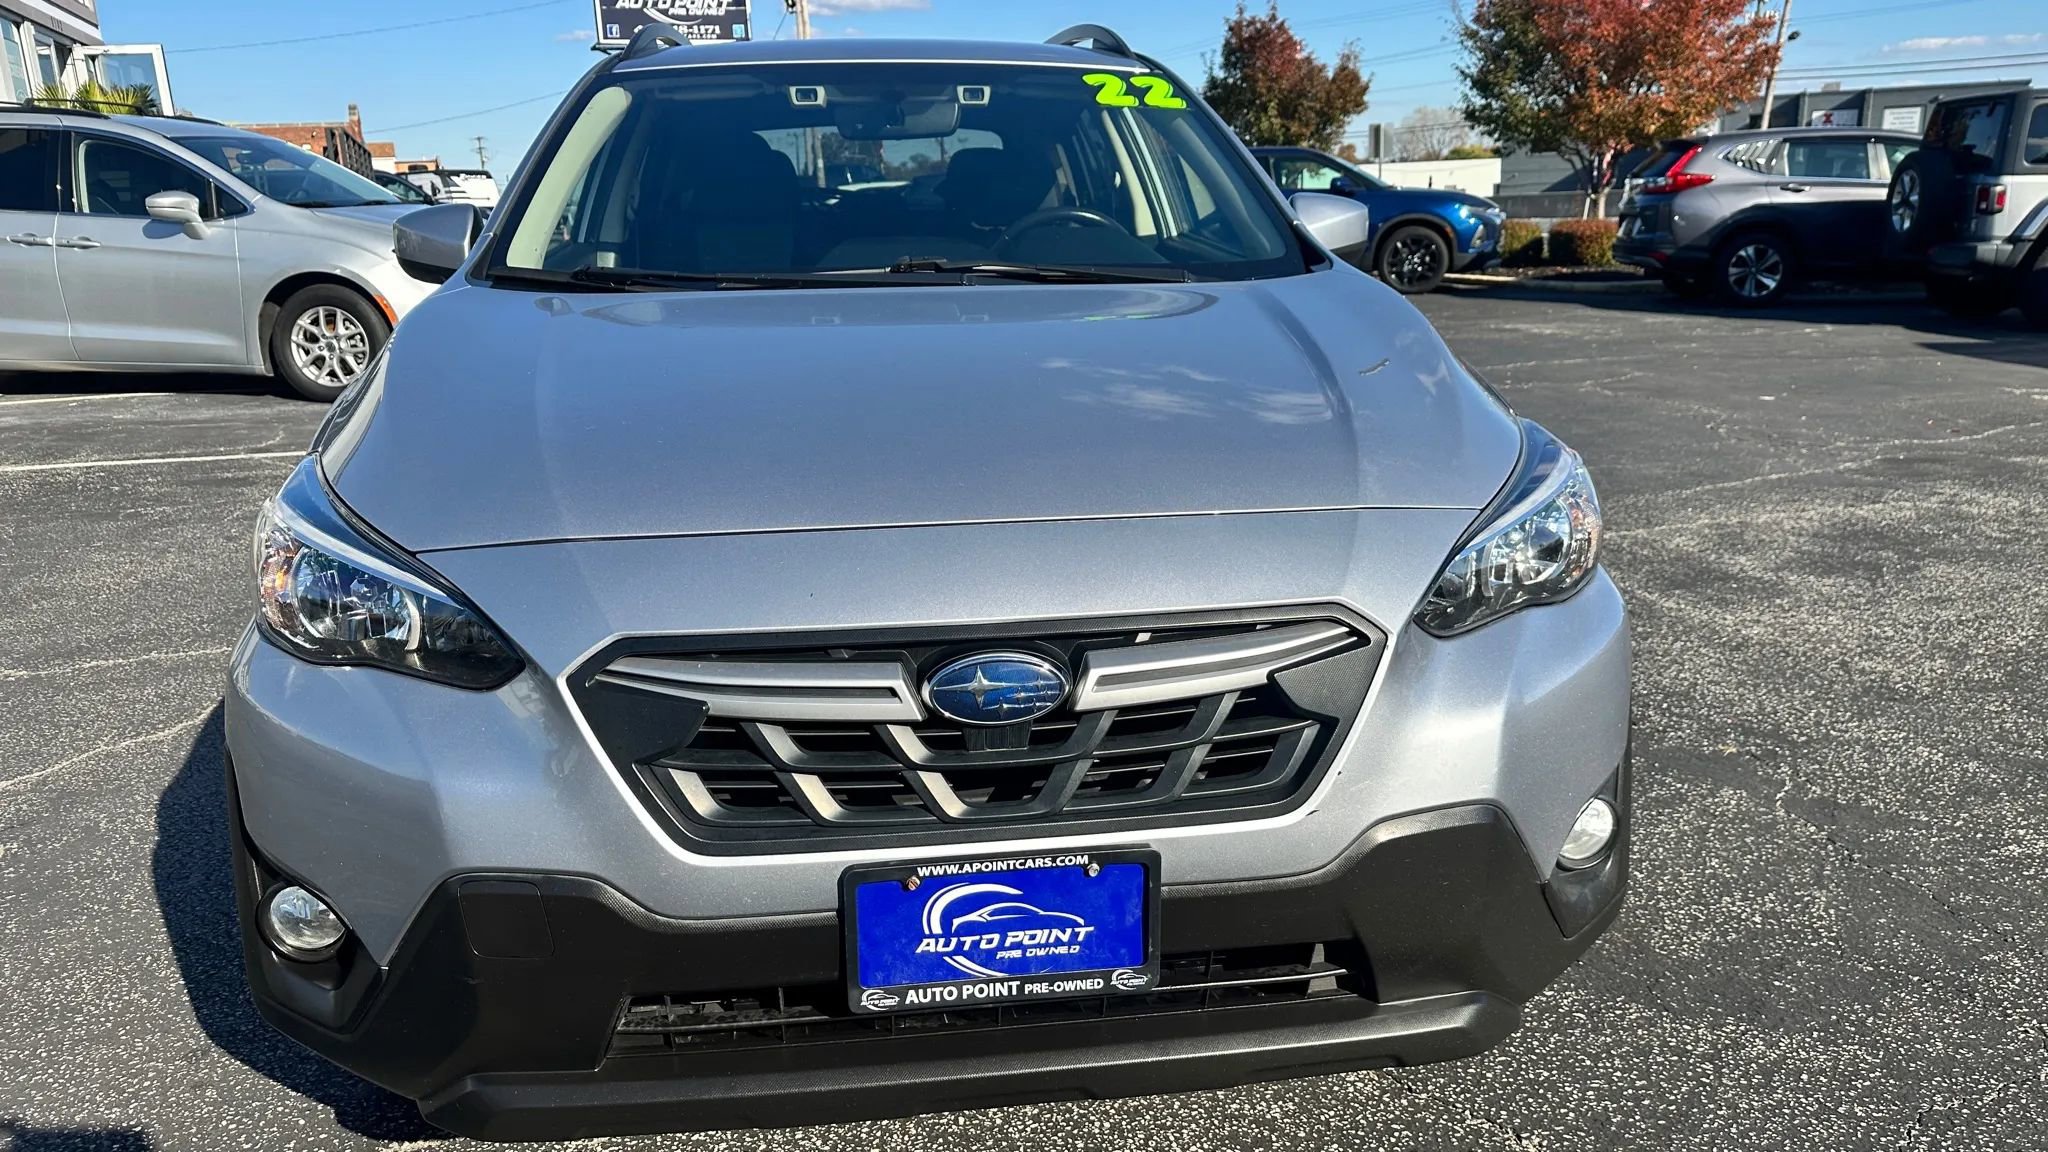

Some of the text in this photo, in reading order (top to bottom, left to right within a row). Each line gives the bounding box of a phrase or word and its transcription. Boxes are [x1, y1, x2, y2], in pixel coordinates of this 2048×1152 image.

[615, 0, 733, 9] AUTO POINT
[1082, 73, 1187, 109] 22
[917, 855, 1088, 877] WWW.APOINTCARS.COM
[915, 926, 1095, 954] AUTO POINT
[996, 945, 1080, 960] PRE OWNED
[905, 978, 1104, 1005] AUTO POINT PRE-OWNED
